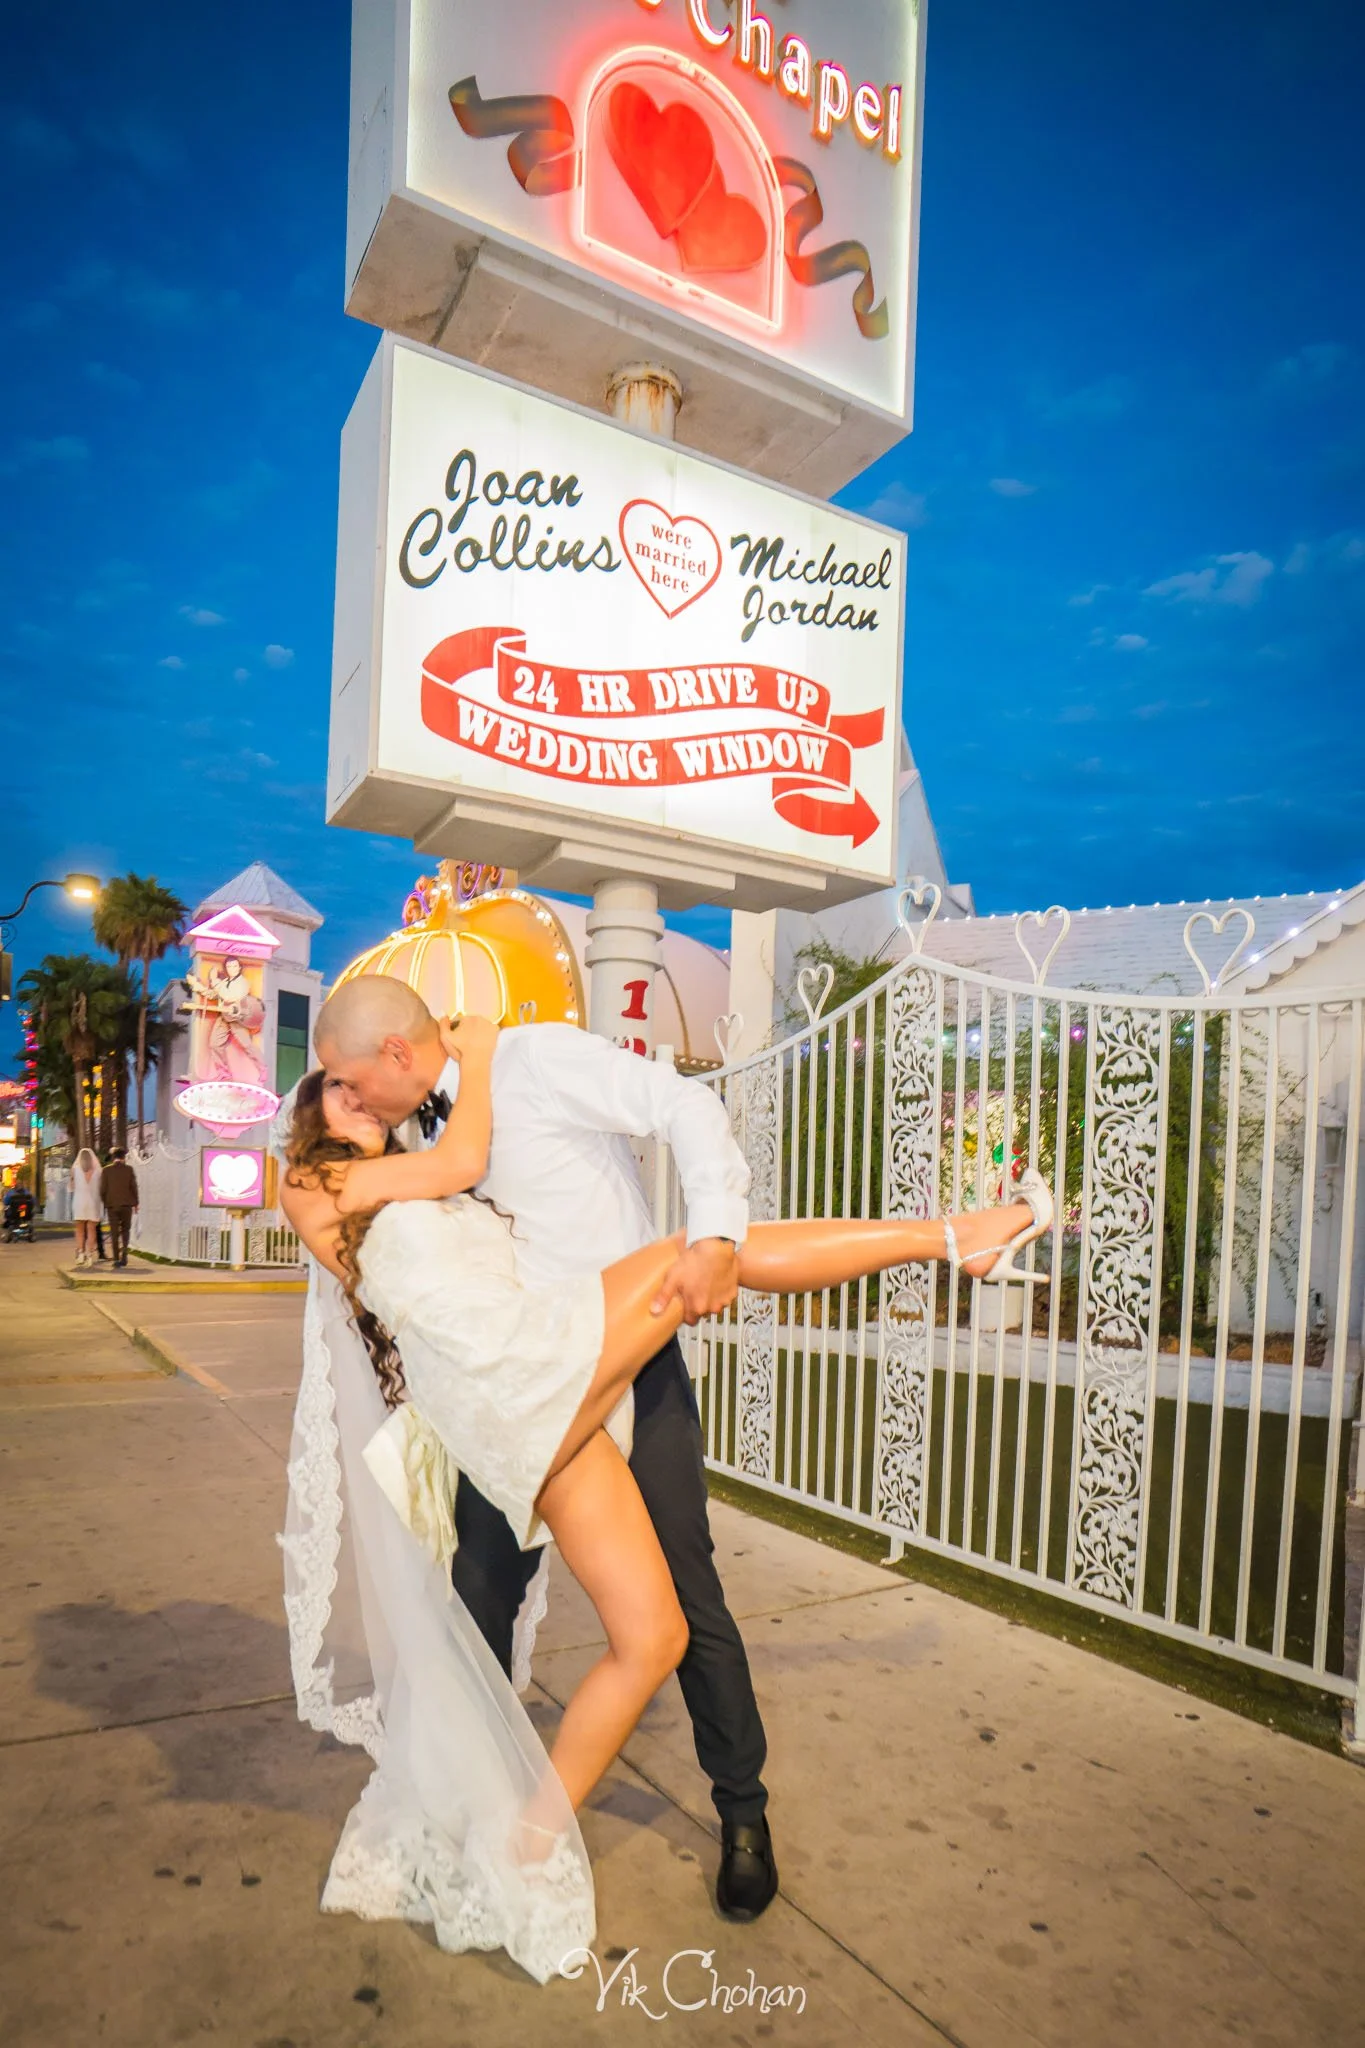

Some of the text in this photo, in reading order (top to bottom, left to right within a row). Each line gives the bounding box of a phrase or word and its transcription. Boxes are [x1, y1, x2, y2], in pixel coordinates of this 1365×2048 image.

[689, 0, 902, 162] Chapel
[445, 449, 583, 533] Joan
[399, 508, 621, 589] Collins
[635, 541, 707, 577] married
[651, 522, 692, 549] were
[730, 533, 891, 590] Michael
[651, 565, 690, 593] here
[741, 585, 880, 642] Jordan
[513, 666, 819, 716] 24 HR DRIVE UP
[457, 698, 829, 781] WEDDING WINDOW
